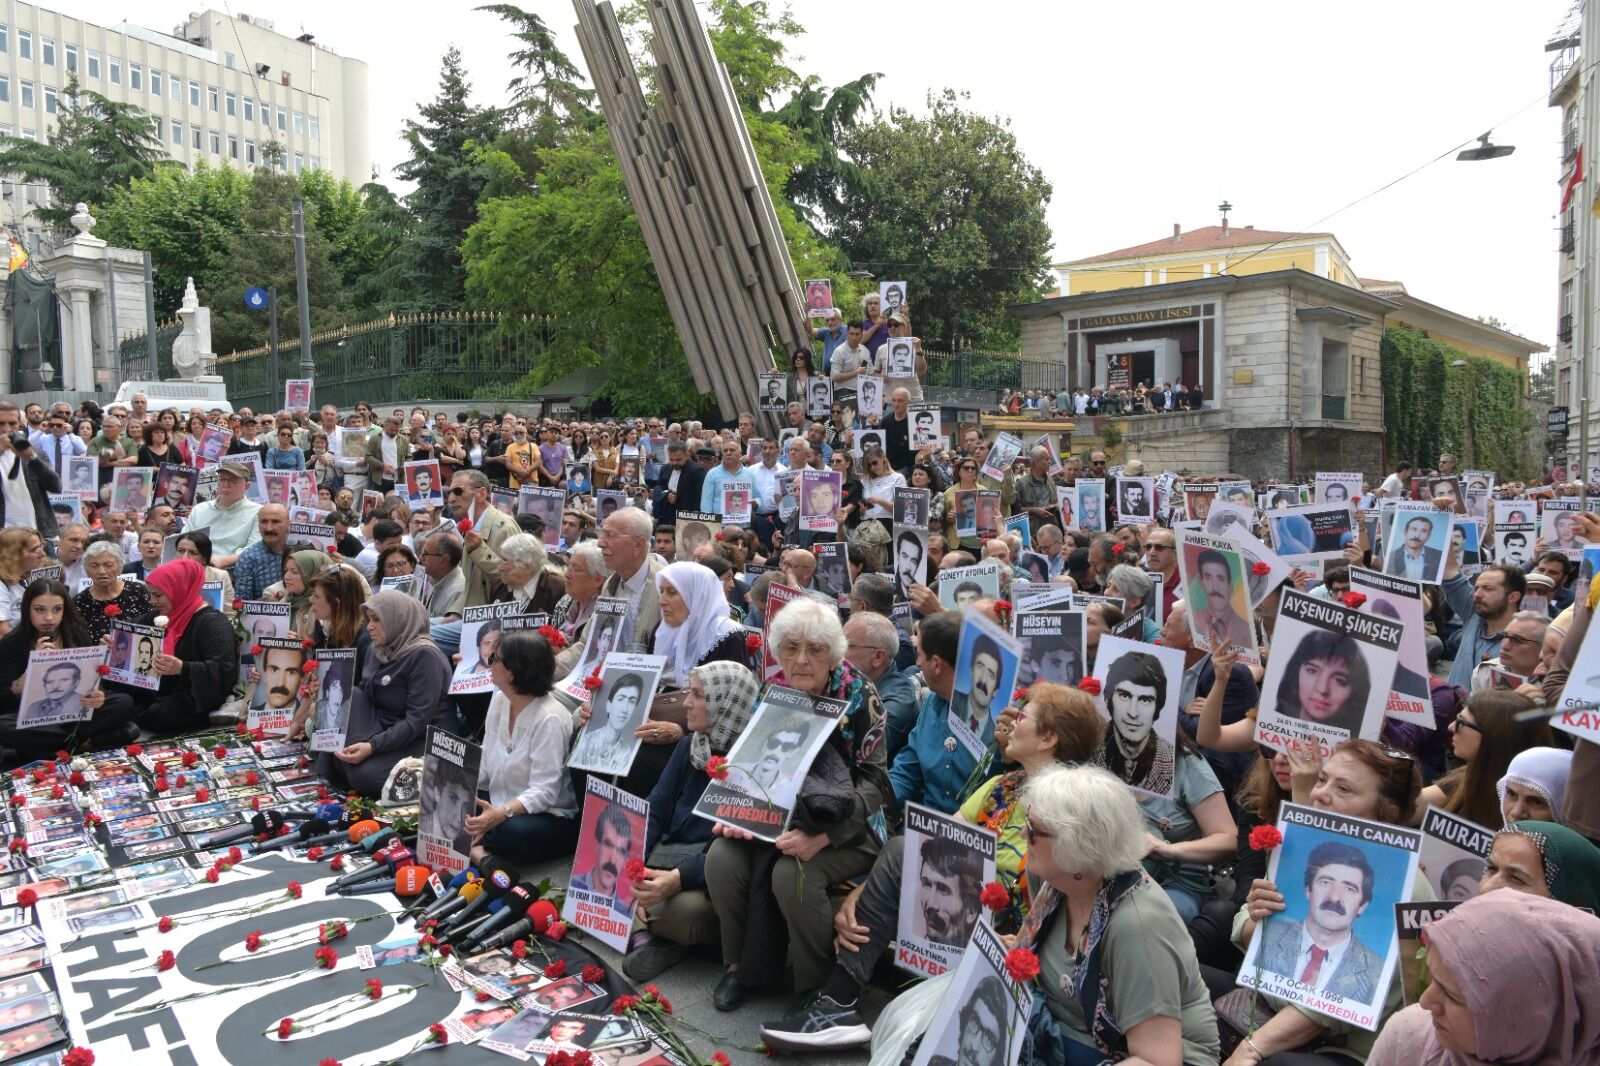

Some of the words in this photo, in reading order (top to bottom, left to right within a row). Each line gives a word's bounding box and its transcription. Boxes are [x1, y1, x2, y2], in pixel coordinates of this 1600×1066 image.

[1086, 313, 1158, 327] GALATASARAY
[1160, 306, 1193, 319] LİSESİ
[541, 490, 565, 498] ALPSOY
[1545, 501, 1568, 510] MURAT
[1570, 501, 1592, 510] YILZ
[678, 511, 698, 520] HASAN
[699, 513, 717, 522] OCAK
[1184, 534, 1211, 548] AHMET
[1212, 538, 1233, 551] KAYA
[940, 569, 964, 581] CÜNEYT
[965, 565, 997, 577] AYDINLAR
[263, 603, 290, 616] KARAKOÇ
[465, 606, 494, 621] HASAN
[496, 602, 519, 618] OCAK
[503, 618, 525, 629] MURAT
[1022, 614, 1061, 628] HÜSEYİN
[1284, 596, 1345, 628] AYŞENUR
[1346, 613, 1401, 644] ŞİMŞEK
[1022, 626, 1063, 636] MORSÜMBÜL
[260, 638, 283, 648] RIDVAN
[768, 690, 815, 709] HAYRETTİN
[815, 701, 844, 714] EREN
[1312, 725, 1349, 739] Ankara'da
[433, 731, 466, 757] HÜSEYİN
[588, 778, 614, 801] FEHMİ
[617, 789, 647, 816] TOSUN
[703, 794, 755, 808] GÖZALTINDA
[715, 806, 785, 826] KAYBEDİLDİ
[909, 812, 940, 834] TALAT
[940, 823, 993, 856] TÜRKOĞLU
[1284, 810, 1360, 838] ABDULLAH
[1362, 828, 1416, 850] CANAN
[1429, 814, 1494, 854] MURAT
[426, 851, 464, 871] KAYBEDİLDİ
[575, 889, 590, 901] EKİM
[576, 902, 610, 918] GÖZALTINDA
[575, 911, 628, 938] KAYBEDİLDİ
[900, 939, 948, 964] GÖZALTINDA
[1273, 974, 1282, 983] 17
[1286, 978, 1317, 995] OCAK
[1320, 989, 1344, 1004] 1996
[1241, 974, 1304, 1003] GÖZALTINDA
[1306, 996, 1374, 1027] KAYBEDİLDİ
